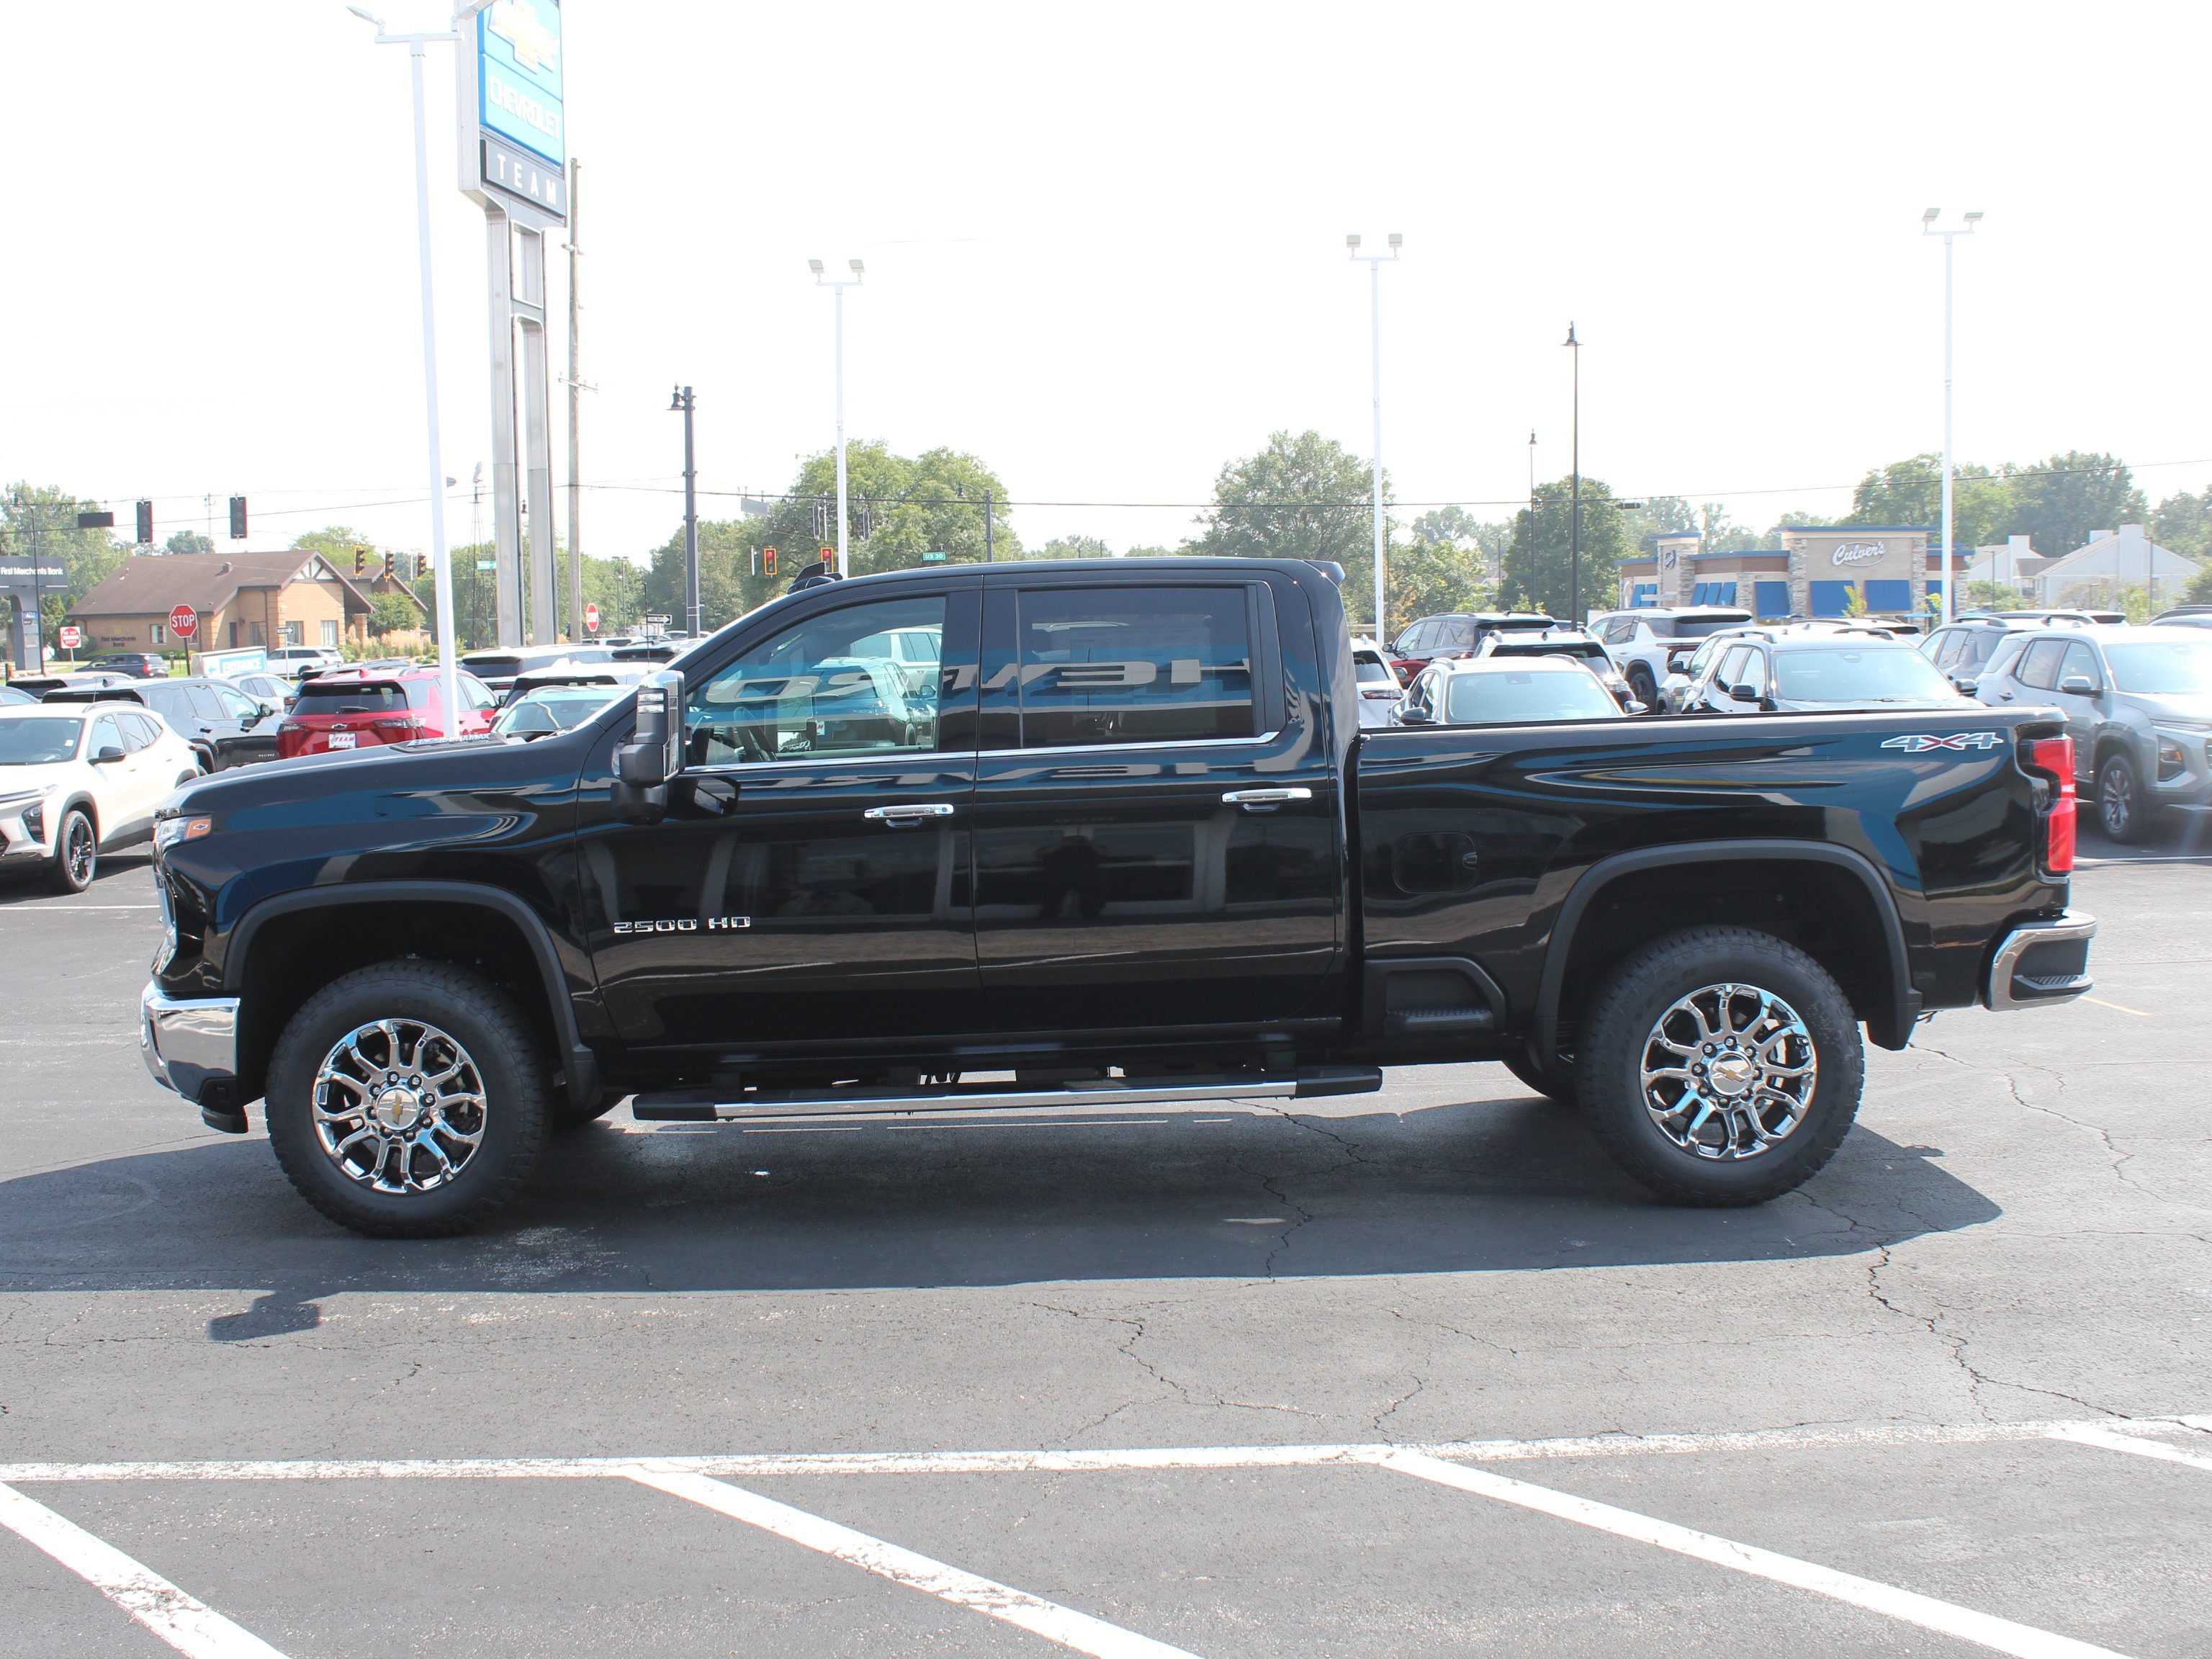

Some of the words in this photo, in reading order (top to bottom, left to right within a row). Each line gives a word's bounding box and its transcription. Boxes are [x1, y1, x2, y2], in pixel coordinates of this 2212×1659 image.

[488, 74, 560, 140] CHEVROLET
[497, 153, 557, 206] TEAM
[1832, 541, 1886, 565] Culver's
[0, 567, 13, 575] First
[48, 567, 63, 575] Bank
[171, 614, 195, 628] STOP
[587, 612, 599, 623] STOP
[613, 919, 697, 933] 2500
[708, 917, 751, 929] HD
